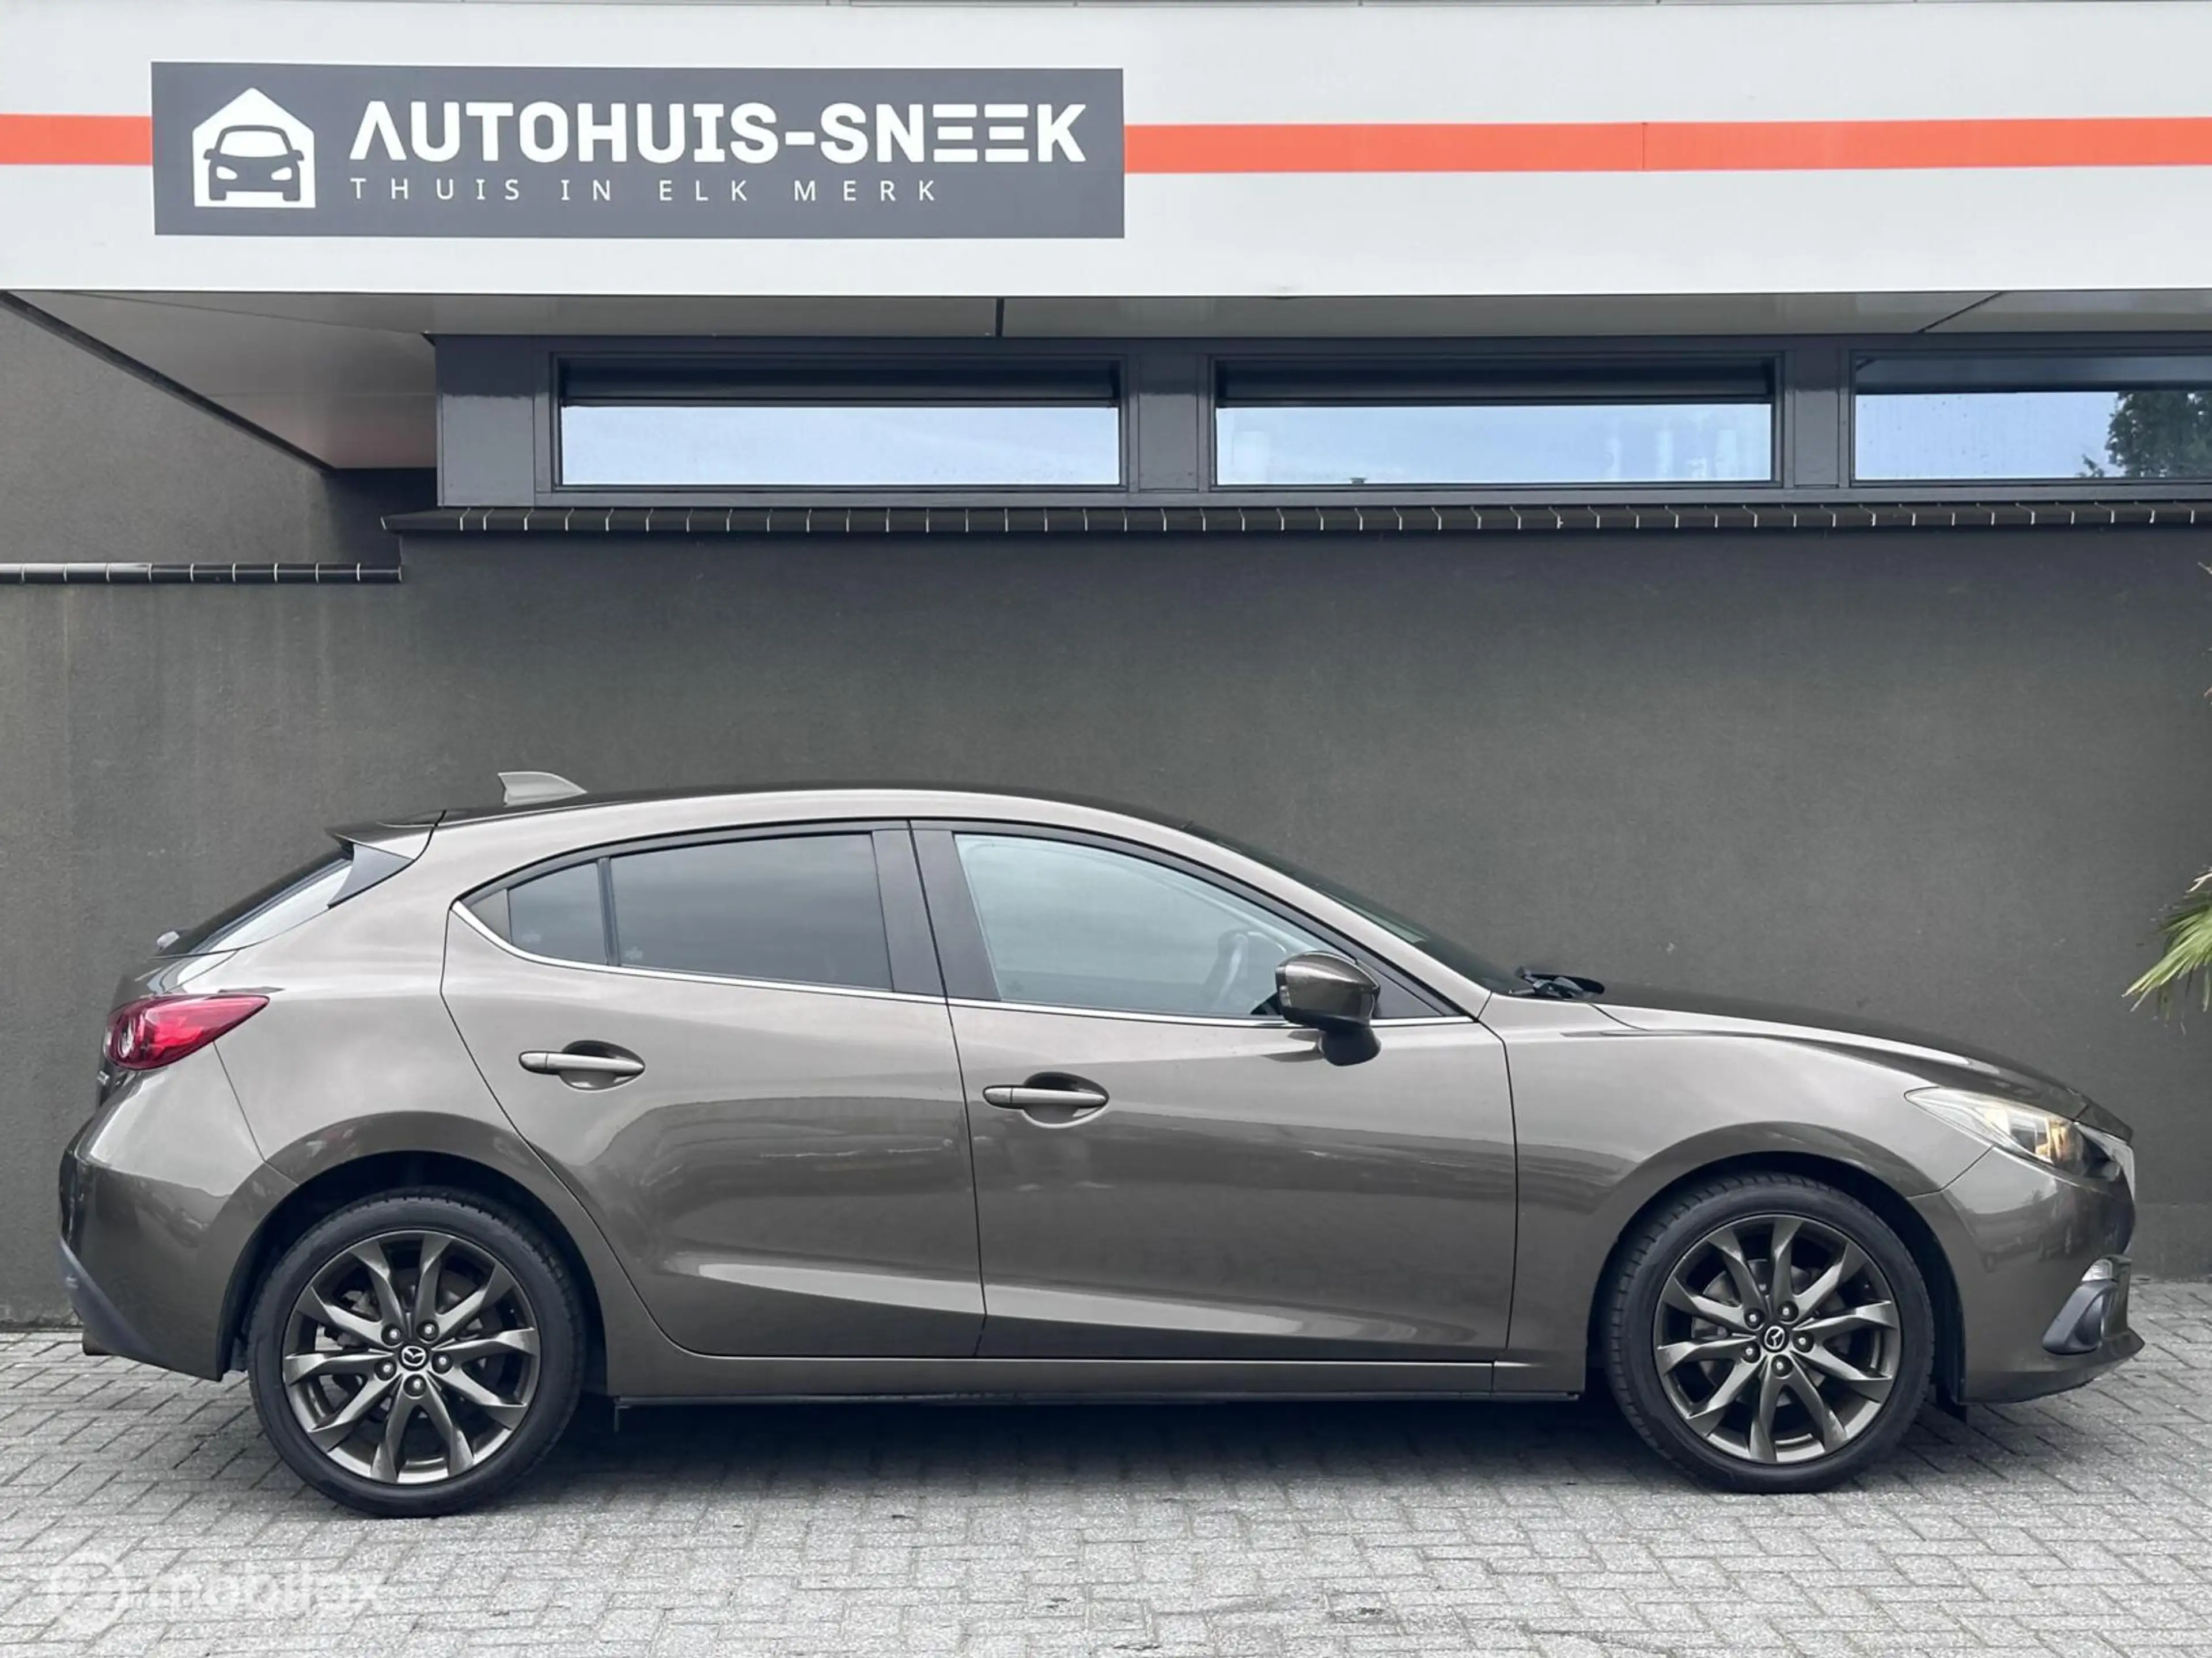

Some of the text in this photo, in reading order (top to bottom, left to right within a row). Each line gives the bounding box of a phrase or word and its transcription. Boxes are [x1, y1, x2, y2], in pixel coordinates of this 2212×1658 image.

[349, 100, 1086, 164] AUTOHUIS-SNEEK
[350, 177, 934, 202] THUIS IN ELK MERK
